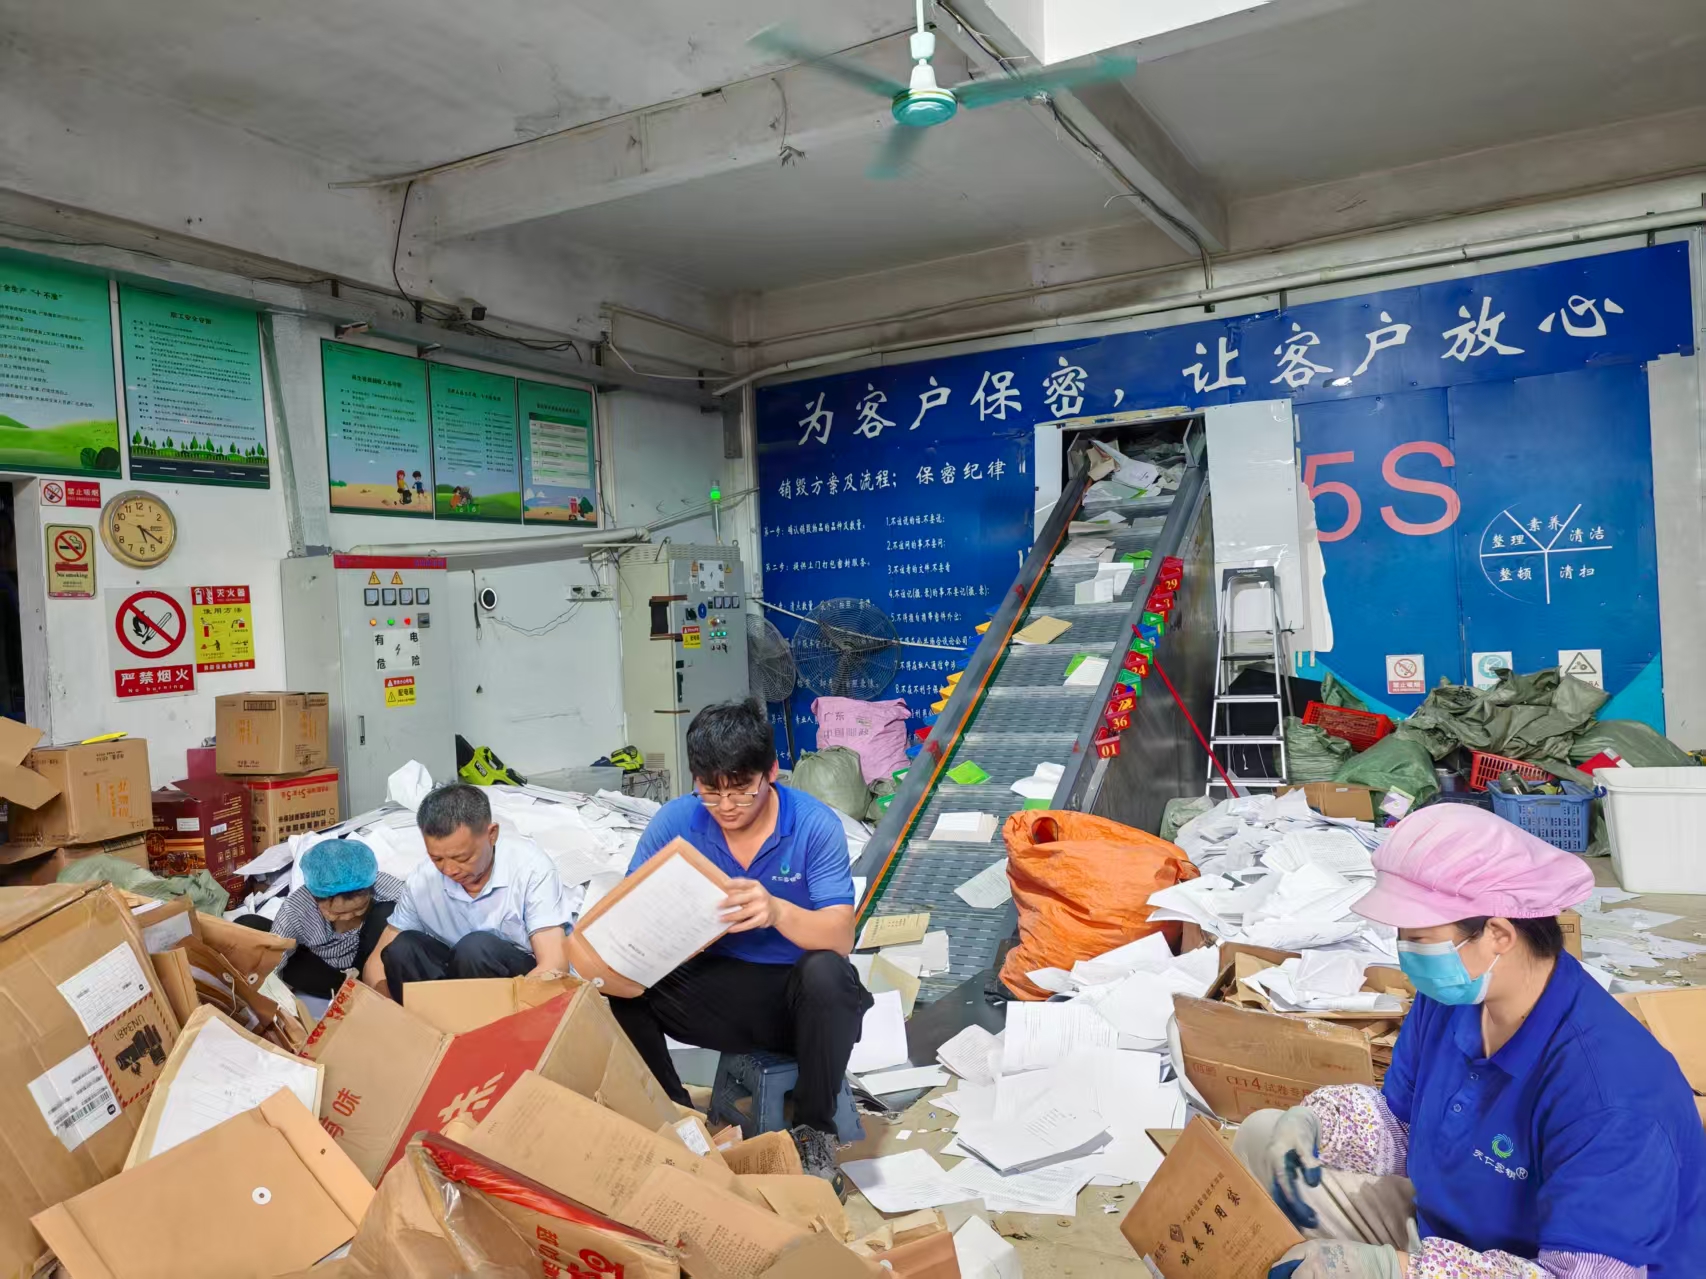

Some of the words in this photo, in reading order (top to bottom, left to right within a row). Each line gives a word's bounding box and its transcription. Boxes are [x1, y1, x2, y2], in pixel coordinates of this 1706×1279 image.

[0, 284, 63, 300] 全生产“十不准”
[798, 294, 1623, 446] 为客户保密，让客户放心
[915, 459, 1006, 485] 保密纪律
[67, 488, 99, 497] 禁止吸烟
[1303, 440, 1461, 542] 5S
[125, 505, 131, 513] 11
[136, 502, 143, 511] 12
[148, 505, 152, 513] 1
[117, 513, 126, 521] 10
[156, 513, 162, 521] 2
[114, 524, 120, 532] 9
[1527, 515, 1562, 532] 素养
[119, 536, 125, 544] 8
[1492, 533, 1527, 548] 整理
[1568, 527, 1605, 543] 清洁
[128, 543, 134, 552] 7
[139, 546, 145, 555] 6
[150, 544, 156, 552] 5
[1498, 567, 1533, 582] 整顿
[1559, 565, 1595, 580] 清扫
[1165, 579, 1178, 590] 29
[216, 588, 246, 598] 灭火器
[375, 634, 384, 646] 有
[410, 632, 419, 643] 电
[377, 658, 386, 670] 危
[411, 655, 420, 666] 险
[1131, 664, 1146, 675] 24
[120, 669, 190, 687] 严禁烟火
[146, 684, 184, 692] burning
[824, 711, 845, 721] 广东
[1112, 716, 1128, 729] 36
[1101, 744, 1117, 757] 01
[114, 1013, 146, 1042] UN3481
[1179, 1185, 1241, 1267] 试卷专用袋
